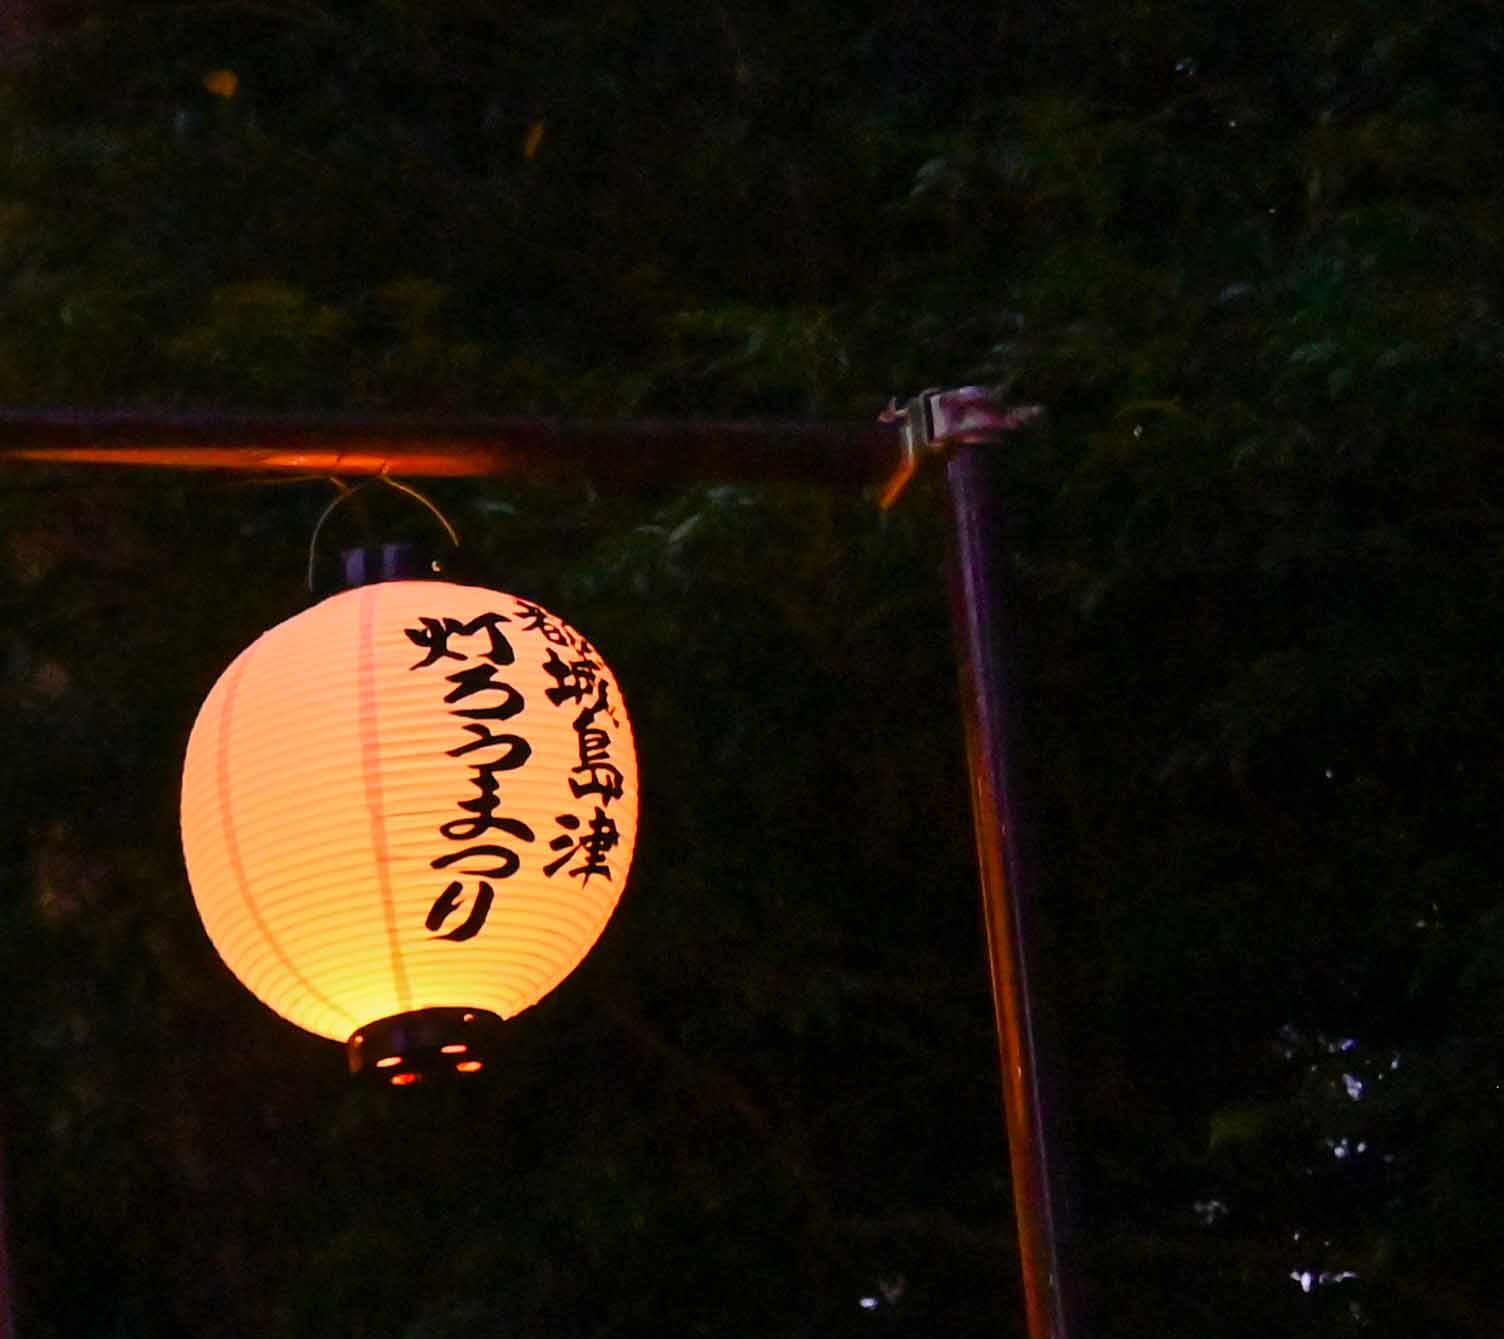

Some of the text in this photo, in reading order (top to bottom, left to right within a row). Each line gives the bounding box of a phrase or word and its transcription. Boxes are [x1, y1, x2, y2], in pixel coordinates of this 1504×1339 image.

[404, 612, 536, 942] 灯ろうまつり
[513, 599, 624, 889] 都城島津
